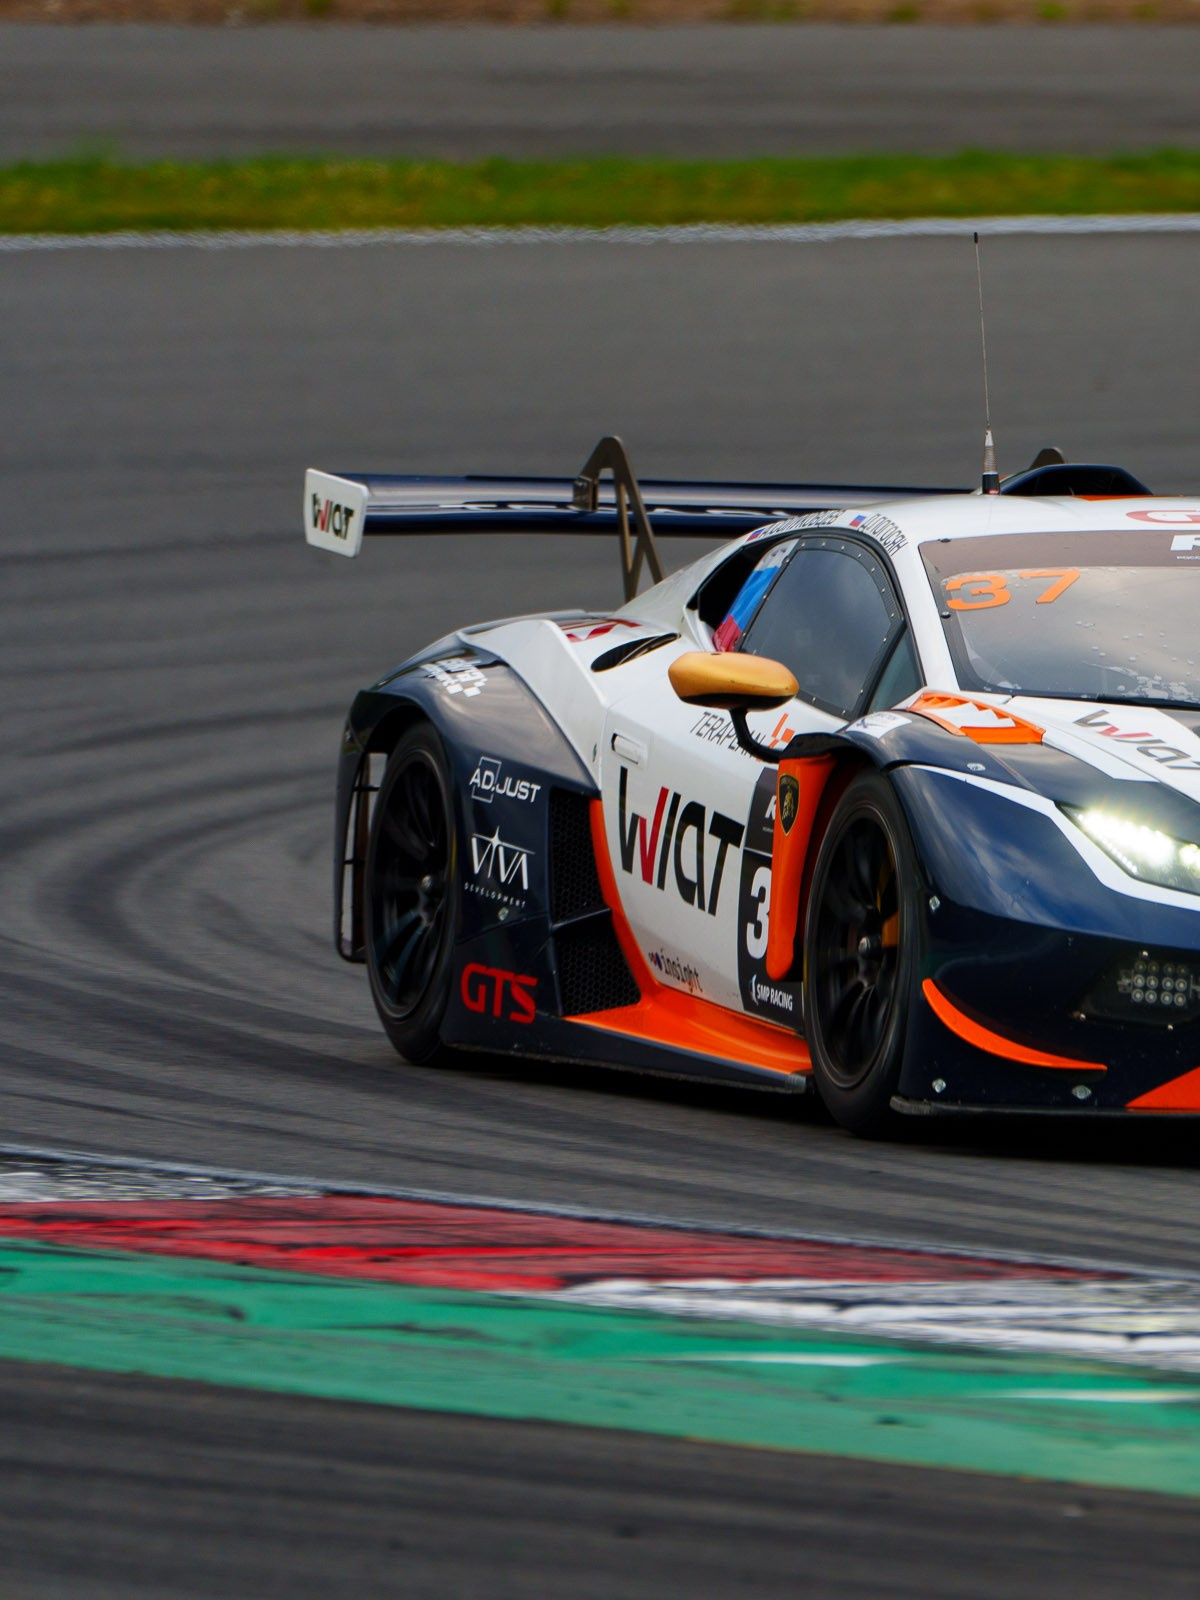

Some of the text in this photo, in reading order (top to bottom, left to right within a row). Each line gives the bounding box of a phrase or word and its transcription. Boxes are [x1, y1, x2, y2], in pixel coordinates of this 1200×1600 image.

[945, 568, 1081, 611] 37
[464, 881, 526, 909] DEVELOPMENT
[660, 948, 704, 993] insight
[461, 962, 539, 1024] GTS
[757, 983, 793, 1012] SMP RACING
